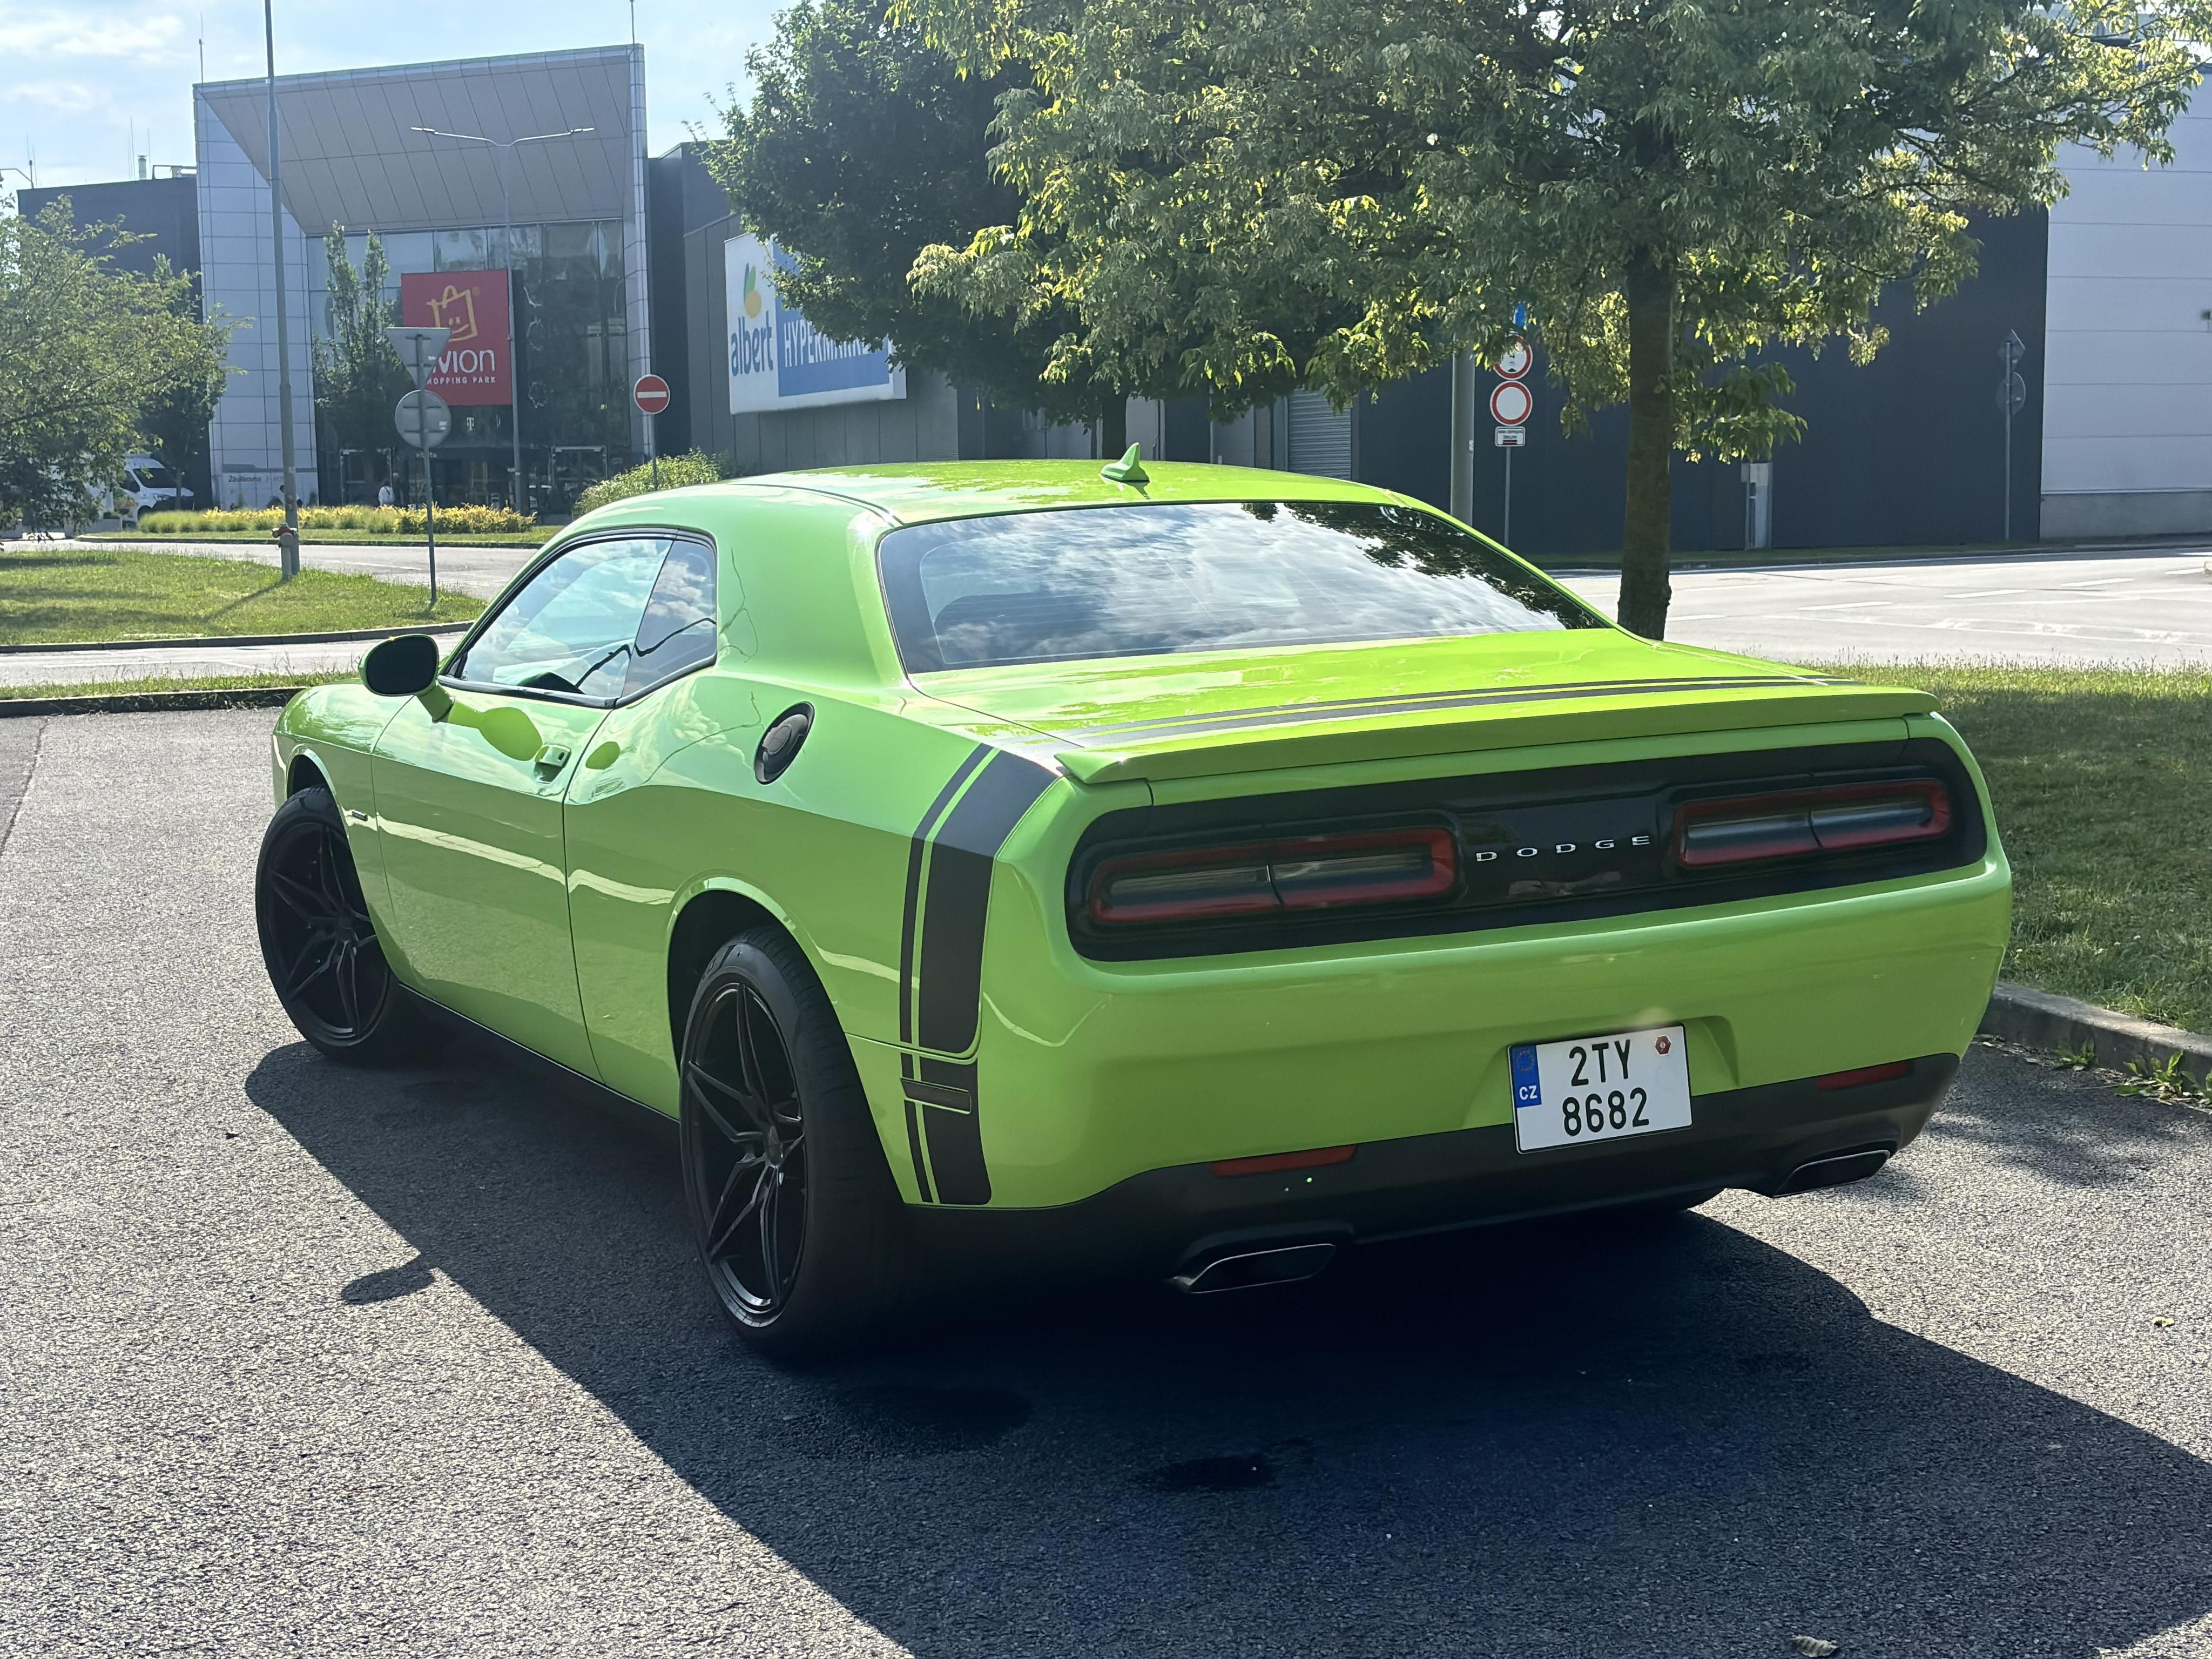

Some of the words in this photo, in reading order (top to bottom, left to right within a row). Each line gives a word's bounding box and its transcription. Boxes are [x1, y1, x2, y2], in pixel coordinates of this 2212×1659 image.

[731, 311, 773, 376] albert
[427, 376, 468, 385] HOPPING
[1476, 835, 1650, 861] DODGE
[1569, 1039, 1631, 1087] 2TY
[1519, 1084, 1537, 1101] CZ
[1562, 1087, 1649, 1136] 8682
